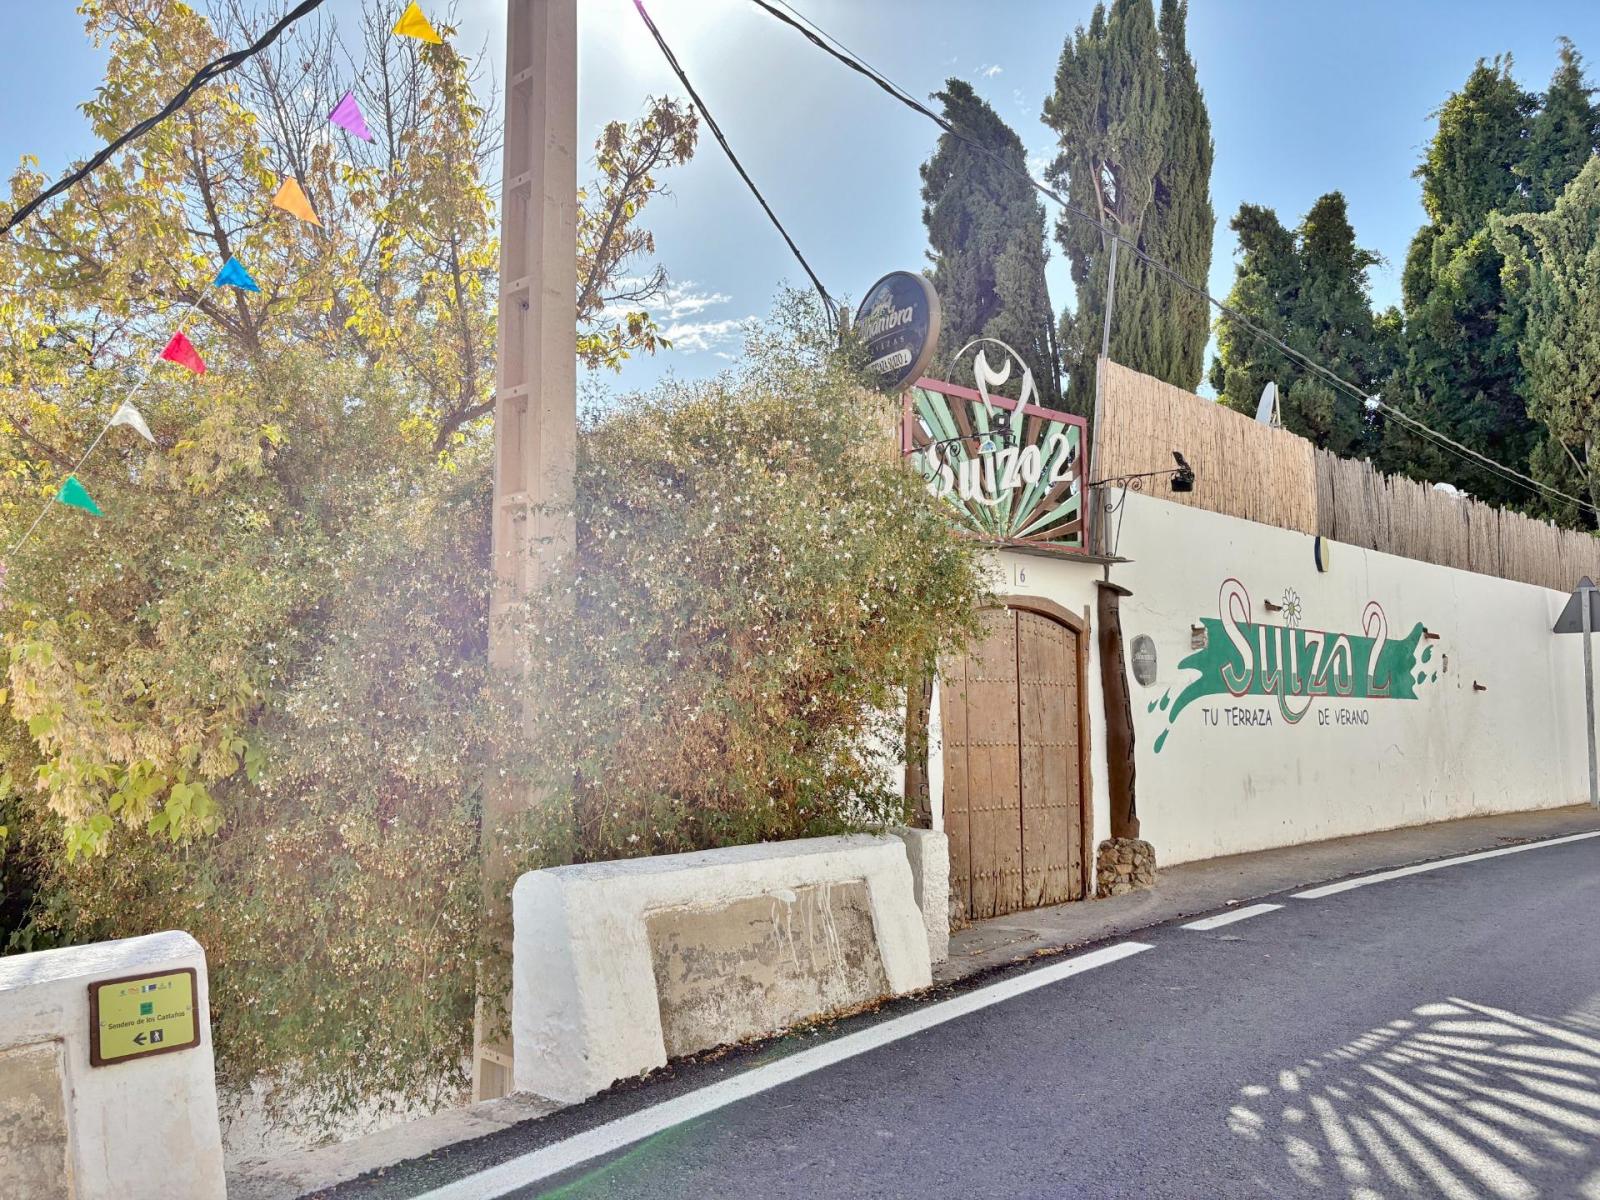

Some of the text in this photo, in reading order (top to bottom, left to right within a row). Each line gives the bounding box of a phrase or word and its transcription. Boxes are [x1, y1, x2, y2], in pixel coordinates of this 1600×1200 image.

[926, 432, 1073, 506] Suizo 2
[1019, 567, 1026, 584] 6
[1362, 600, 1391, 698] 2
[1202, 706, 1370, 726] TU TERRAZA DE VERANO
[108, 1021, 135, 1030] Sendero
[136, 1018, 145, 1026] de
